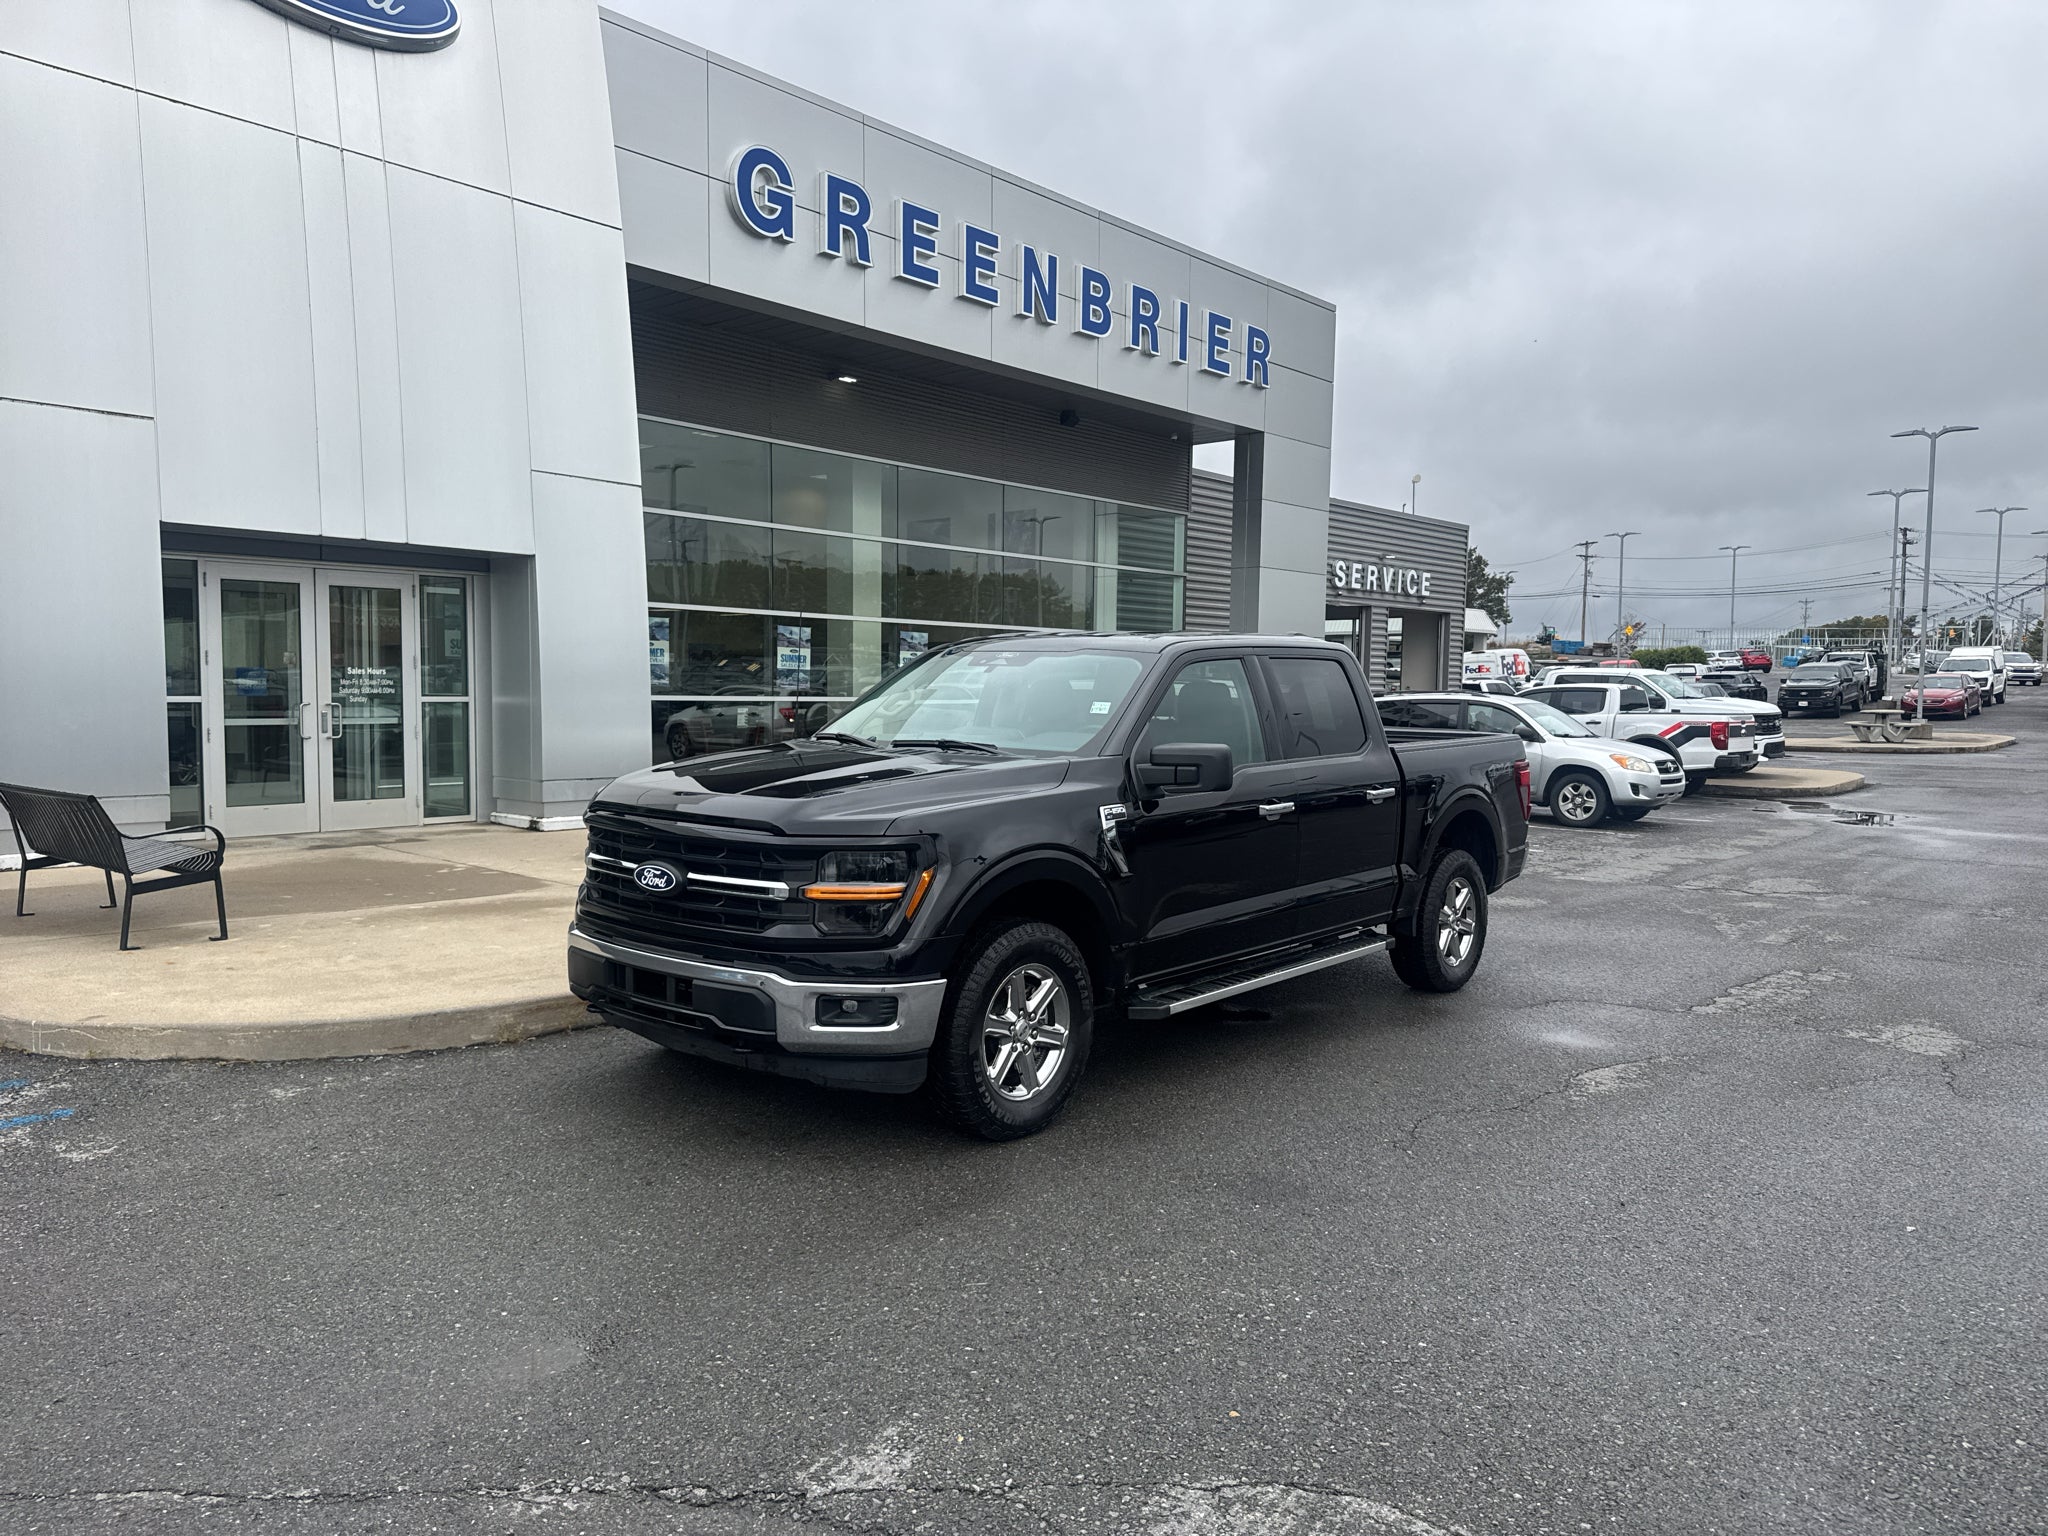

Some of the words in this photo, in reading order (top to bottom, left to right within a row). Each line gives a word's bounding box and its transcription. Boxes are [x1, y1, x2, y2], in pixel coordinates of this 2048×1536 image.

[730, 144, 1272, 389] GREENBRIER
[1334, 560, 1431, 596] SERVICE
[780, 653, 807, 664] SUMMER
[1464, 664, 1491, 675] FedEx
[1500, 653, 1527, 676] FedEx
[347, 666, 366, 675] Sales
[366, 666, 387, 675] Hours
[340, 678, 358, 686] Mon-Fri
[339, 686, 360, 695] Saturday
[349, 695, 368, 704] Sunday
[1105, 807, 1125, 815] F-150
[641, 867, 668, 888] Ford
[1050, 942, 1090, 1009] OODYEAR
